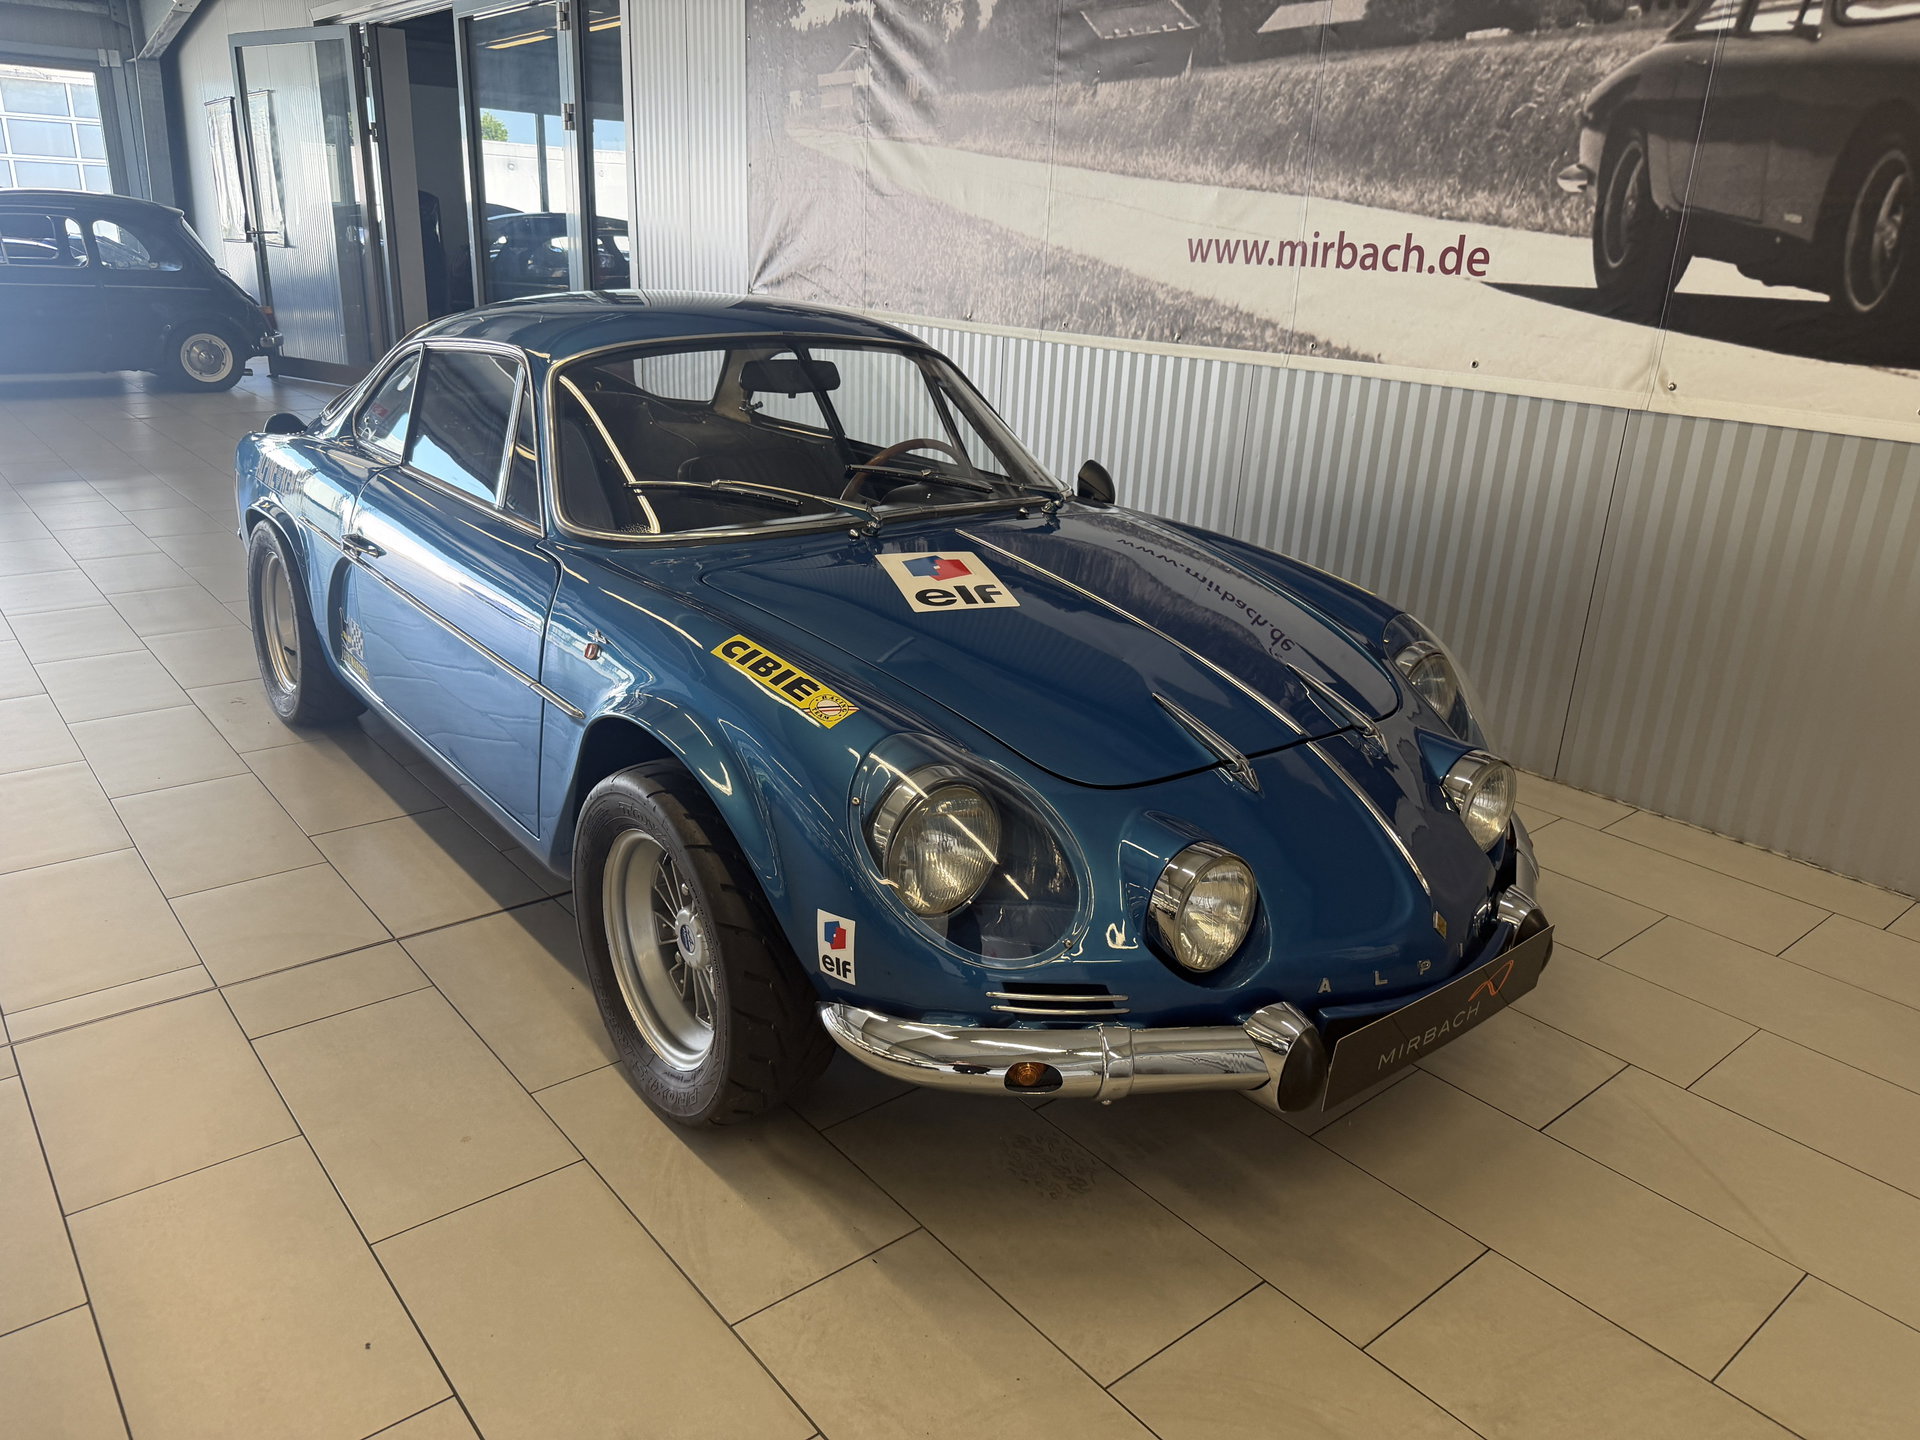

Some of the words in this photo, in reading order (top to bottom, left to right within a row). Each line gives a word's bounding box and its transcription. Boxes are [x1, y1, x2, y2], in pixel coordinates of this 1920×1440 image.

[1187, 230, 1491, 278] www.mirbach.de
[915, 584, 1003, 607] elf
[821, 954, 852, 979] elf
[1377, 1001, 1481, 1071] MIRBACH
